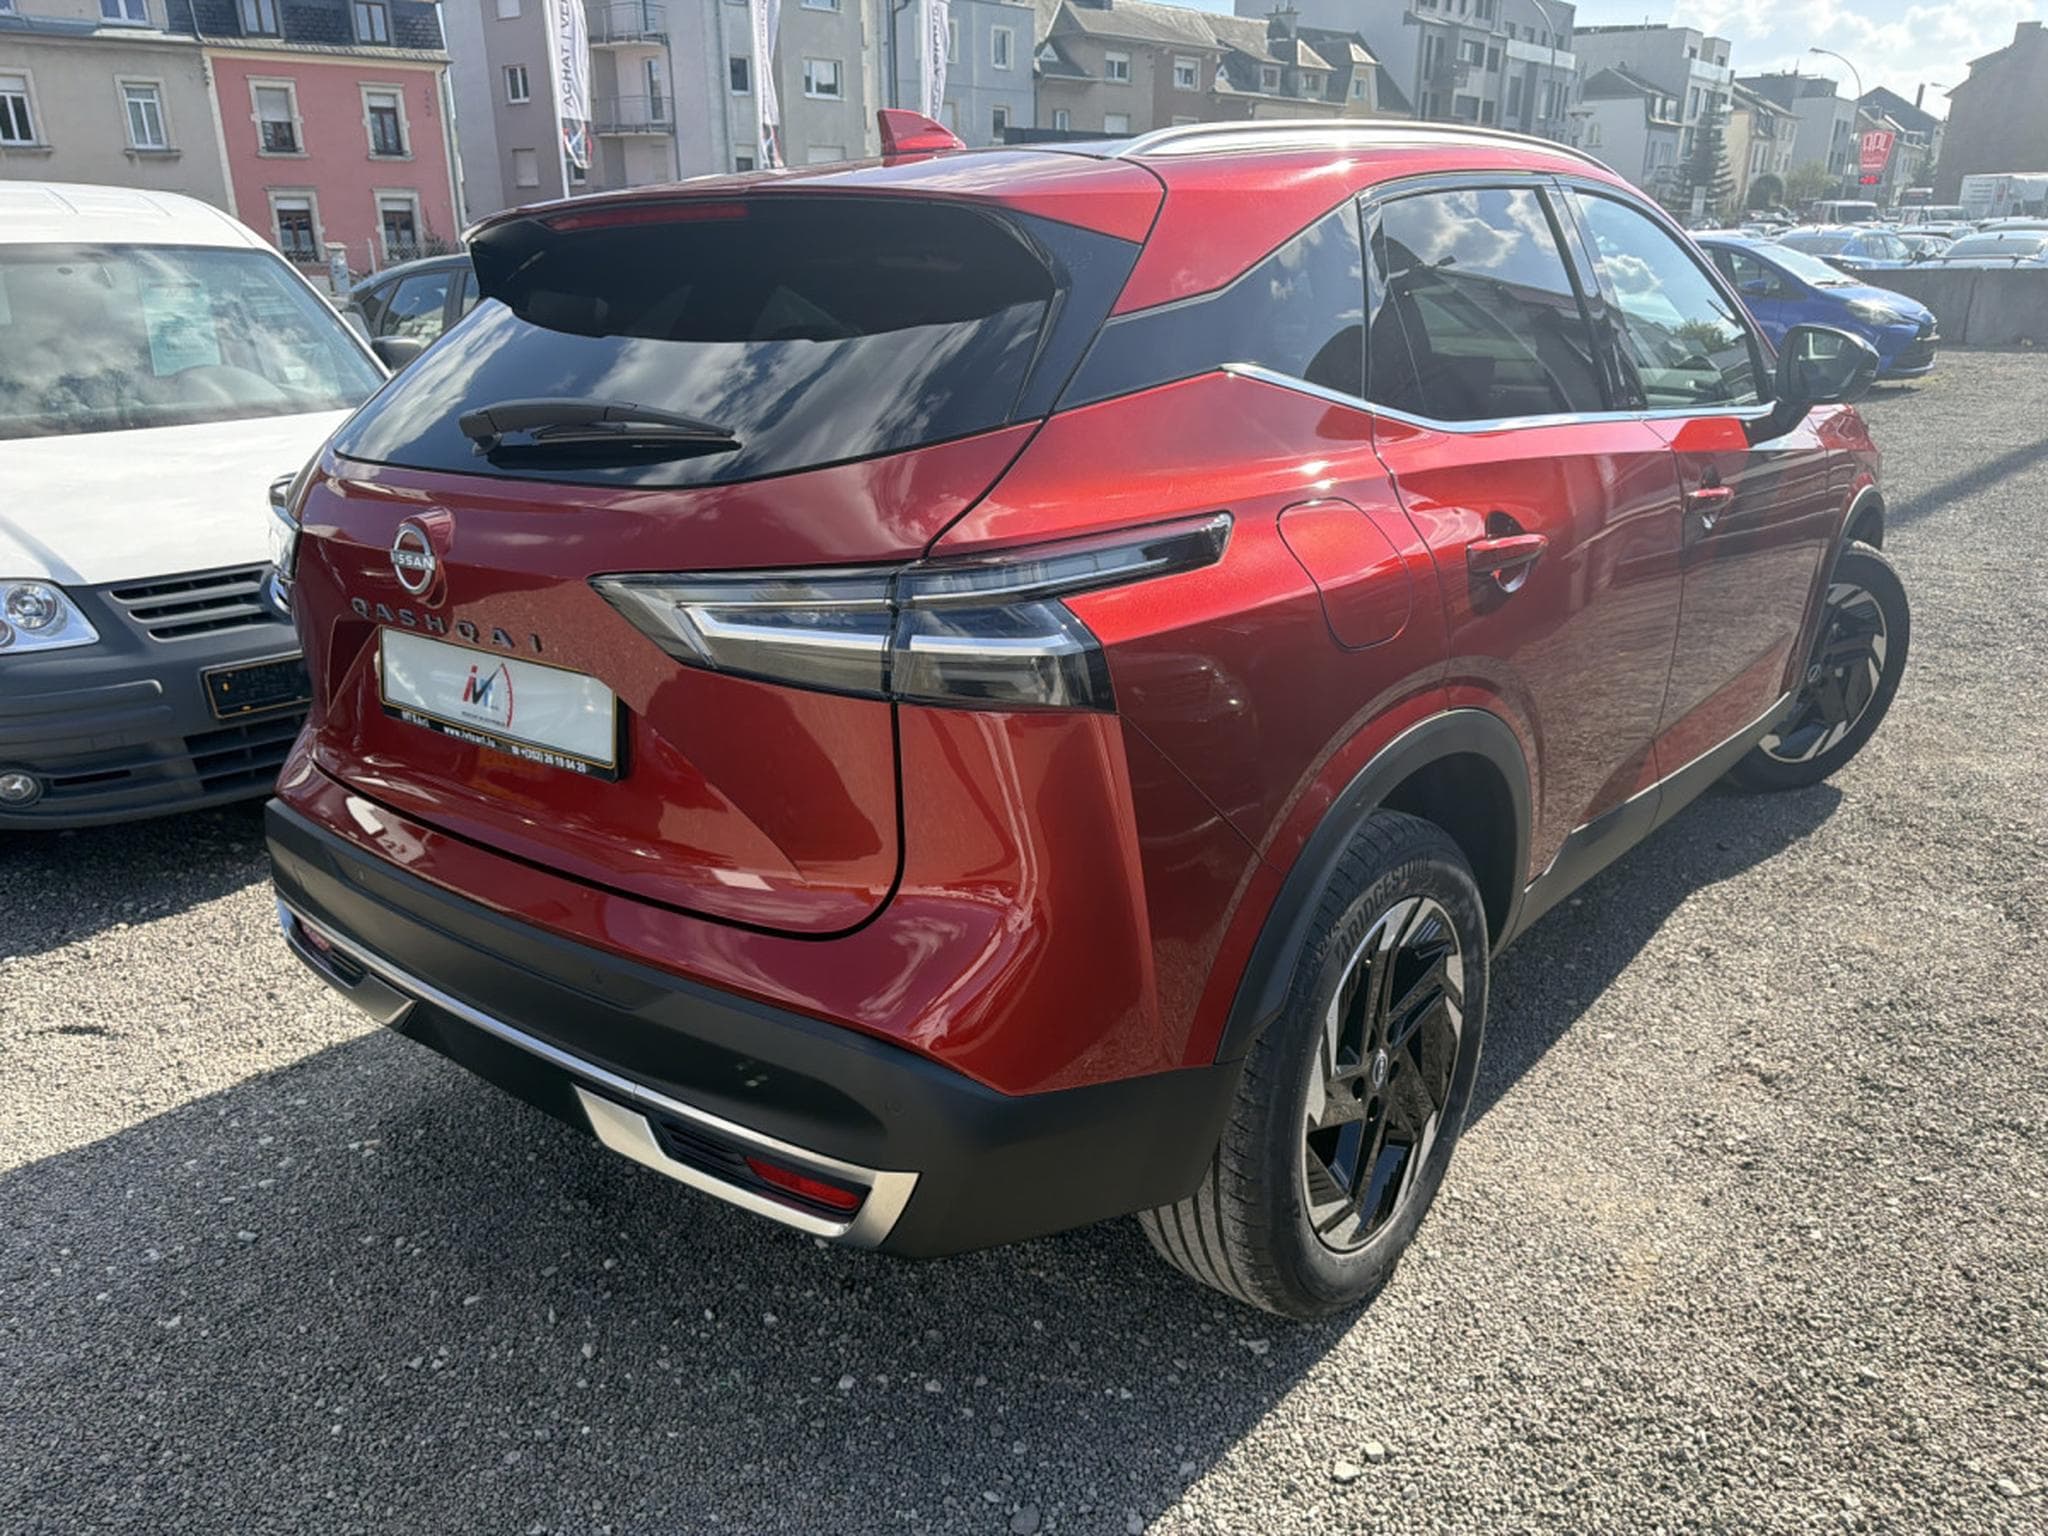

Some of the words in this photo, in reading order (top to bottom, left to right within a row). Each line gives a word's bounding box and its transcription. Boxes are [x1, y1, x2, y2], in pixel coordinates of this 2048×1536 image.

[560, 0, 569, 28] VE
[560, 45, 573, 108] ACHAT
[392, 551, 434, 570] SSAN
[351, 597, 543, 653] QASHQAI
